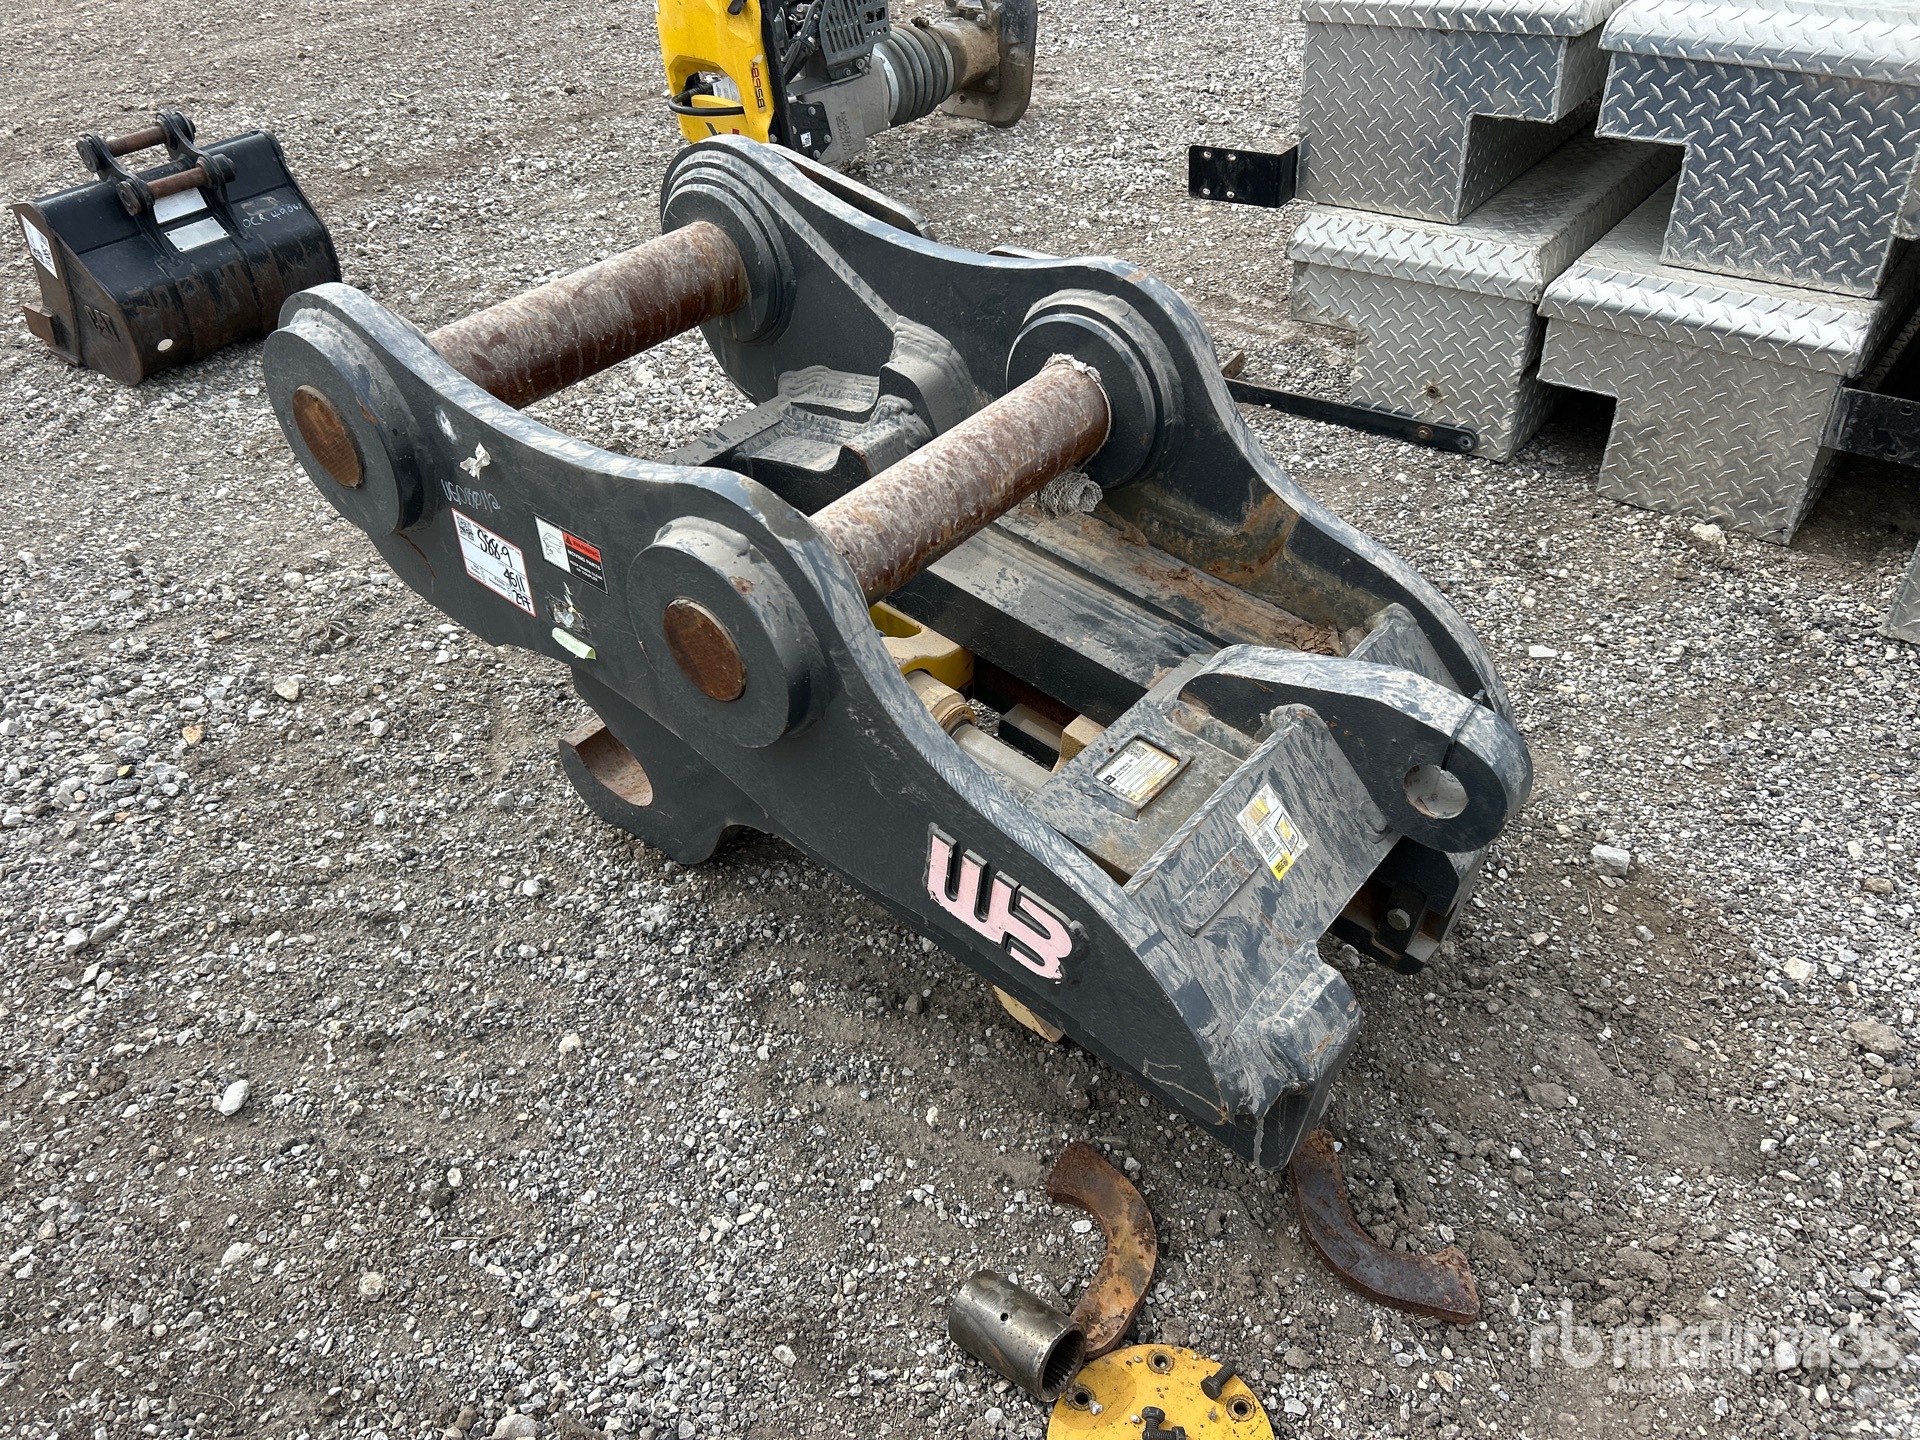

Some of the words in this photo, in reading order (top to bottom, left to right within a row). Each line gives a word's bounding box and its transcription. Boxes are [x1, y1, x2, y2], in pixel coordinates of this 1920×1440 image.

[242, 211, 269, 230] OCR
[567, 549, 586, 563] MOVING
[586, 559, 601, 571] PARTS
